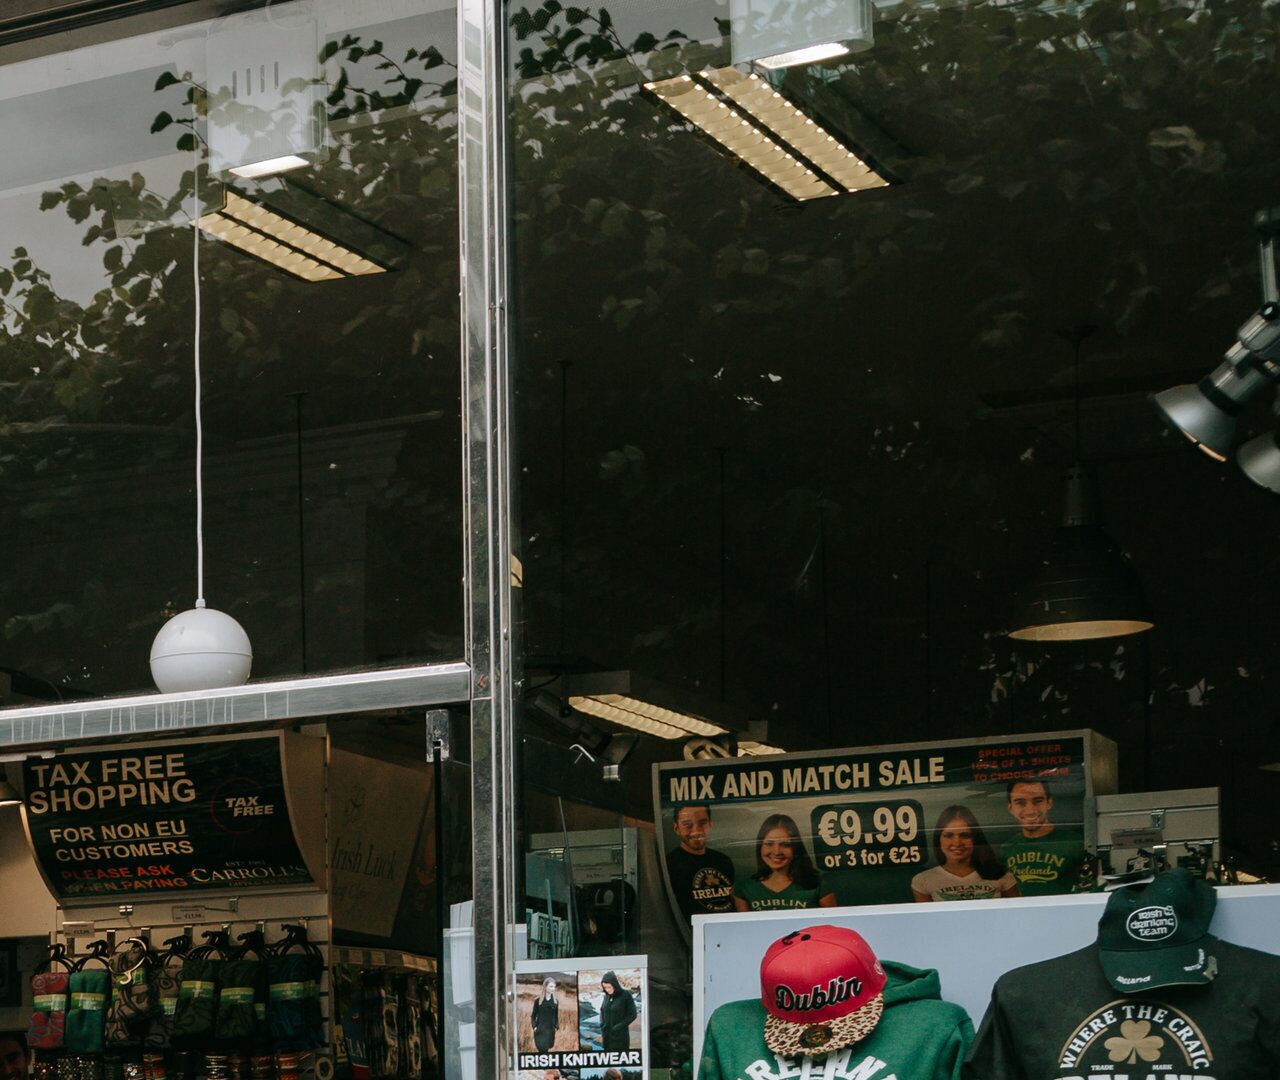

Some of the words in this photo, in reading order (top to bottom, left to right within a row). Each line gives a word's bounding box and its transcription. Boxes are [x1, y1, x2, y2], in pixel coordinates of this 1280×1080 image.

[31, 760, 90, 788] TAX
[101, 753, 186, 783] FREE
[670, 775, 714, 802] MIX
[723, 770, 775, 797] AND
[783, 762, 871, 793] MATCH
[879, 757, 945, 786] SALE
[30, 778, 196, 814] SHOPPING
[225, 796, 259, 808] TAX
[233, 804, 274, 817] FREE
[50, 826, 96, 844] FOR
[102, 823, 150, 842] NON
[156, 819, 187, 837] EU
[818, 805, 918, 848] €9.99
[56, 840, 194, 862] CUSTOMERS
[824, 853, 841, 869] or
[845, 850, 857, 866] 3
[860, 848, 884, 864] for
[888, 845, 920, 865] €25
[1008, 851, 1067, 869] DUBLIN
[61, 866, 134, 882] PLEASE
[137, 864, 175, 877] ASK
[775, 976, 863, 1012] Dublin
[1060, 1009, 1117, 1069] WHERE
[1122, 1005, 1165, 1023] THE
[1168, 1017, 1210, 1070] CRAIC
[521, 1054, 559, 1068] IRISH
[563, 1051, 640, 1066] KNITWEAR
